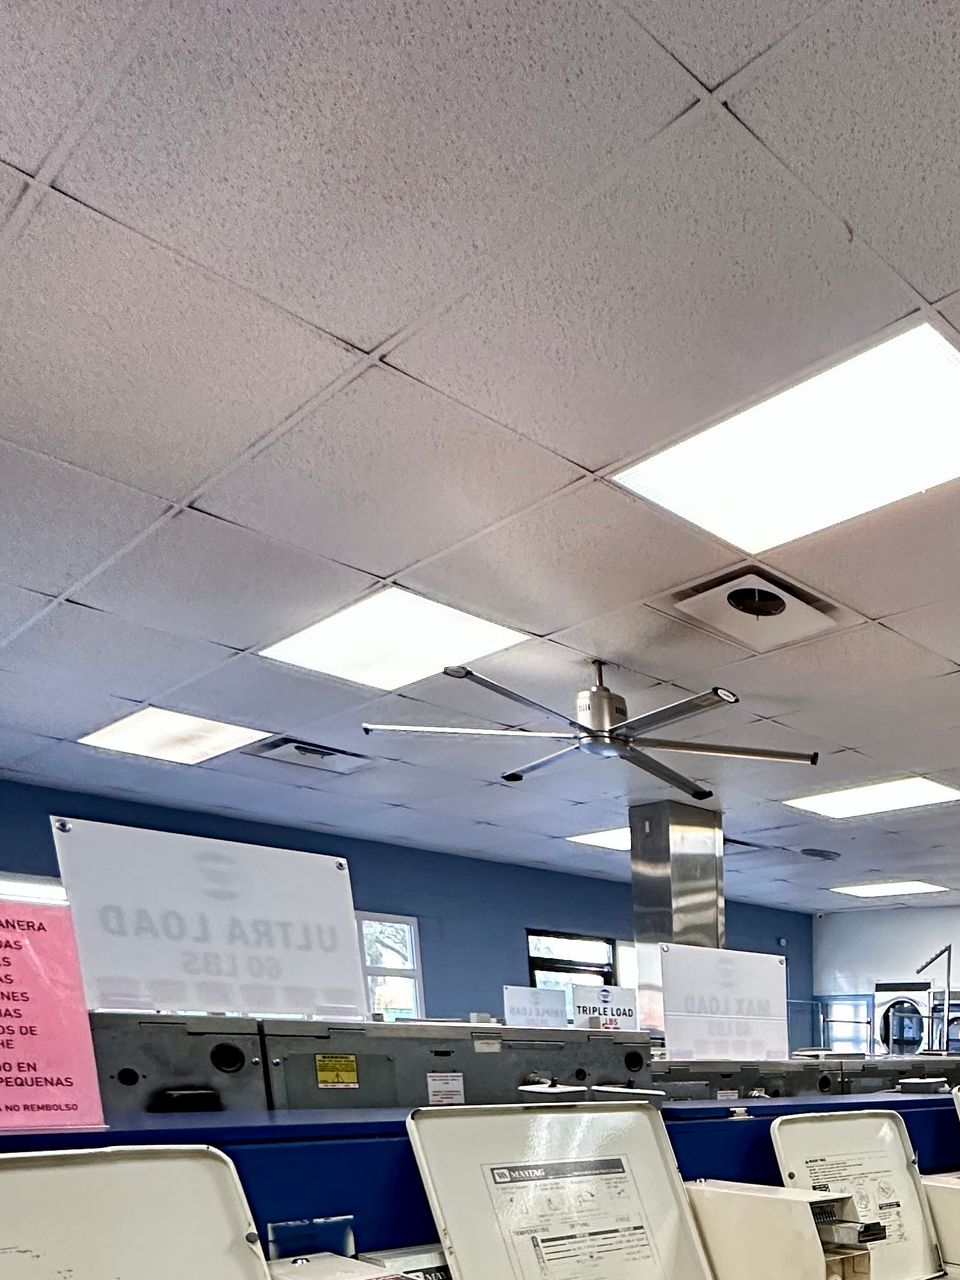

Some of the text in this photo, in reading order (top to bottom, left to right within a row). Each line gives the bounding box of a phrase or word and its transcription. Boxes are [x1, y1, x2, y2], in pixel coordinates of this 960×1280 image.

[576, 1005, 634, 1017] TRIPLE LOAD
[19, 1025, 38, 1036] DE
[17, 1062, 38, 1073] EN
[5, 1104, 21, 1112] NO
[23, 1103, 79, 1112] REMBOLSO
[510, 1169, 545, 1179] MAYTAG
